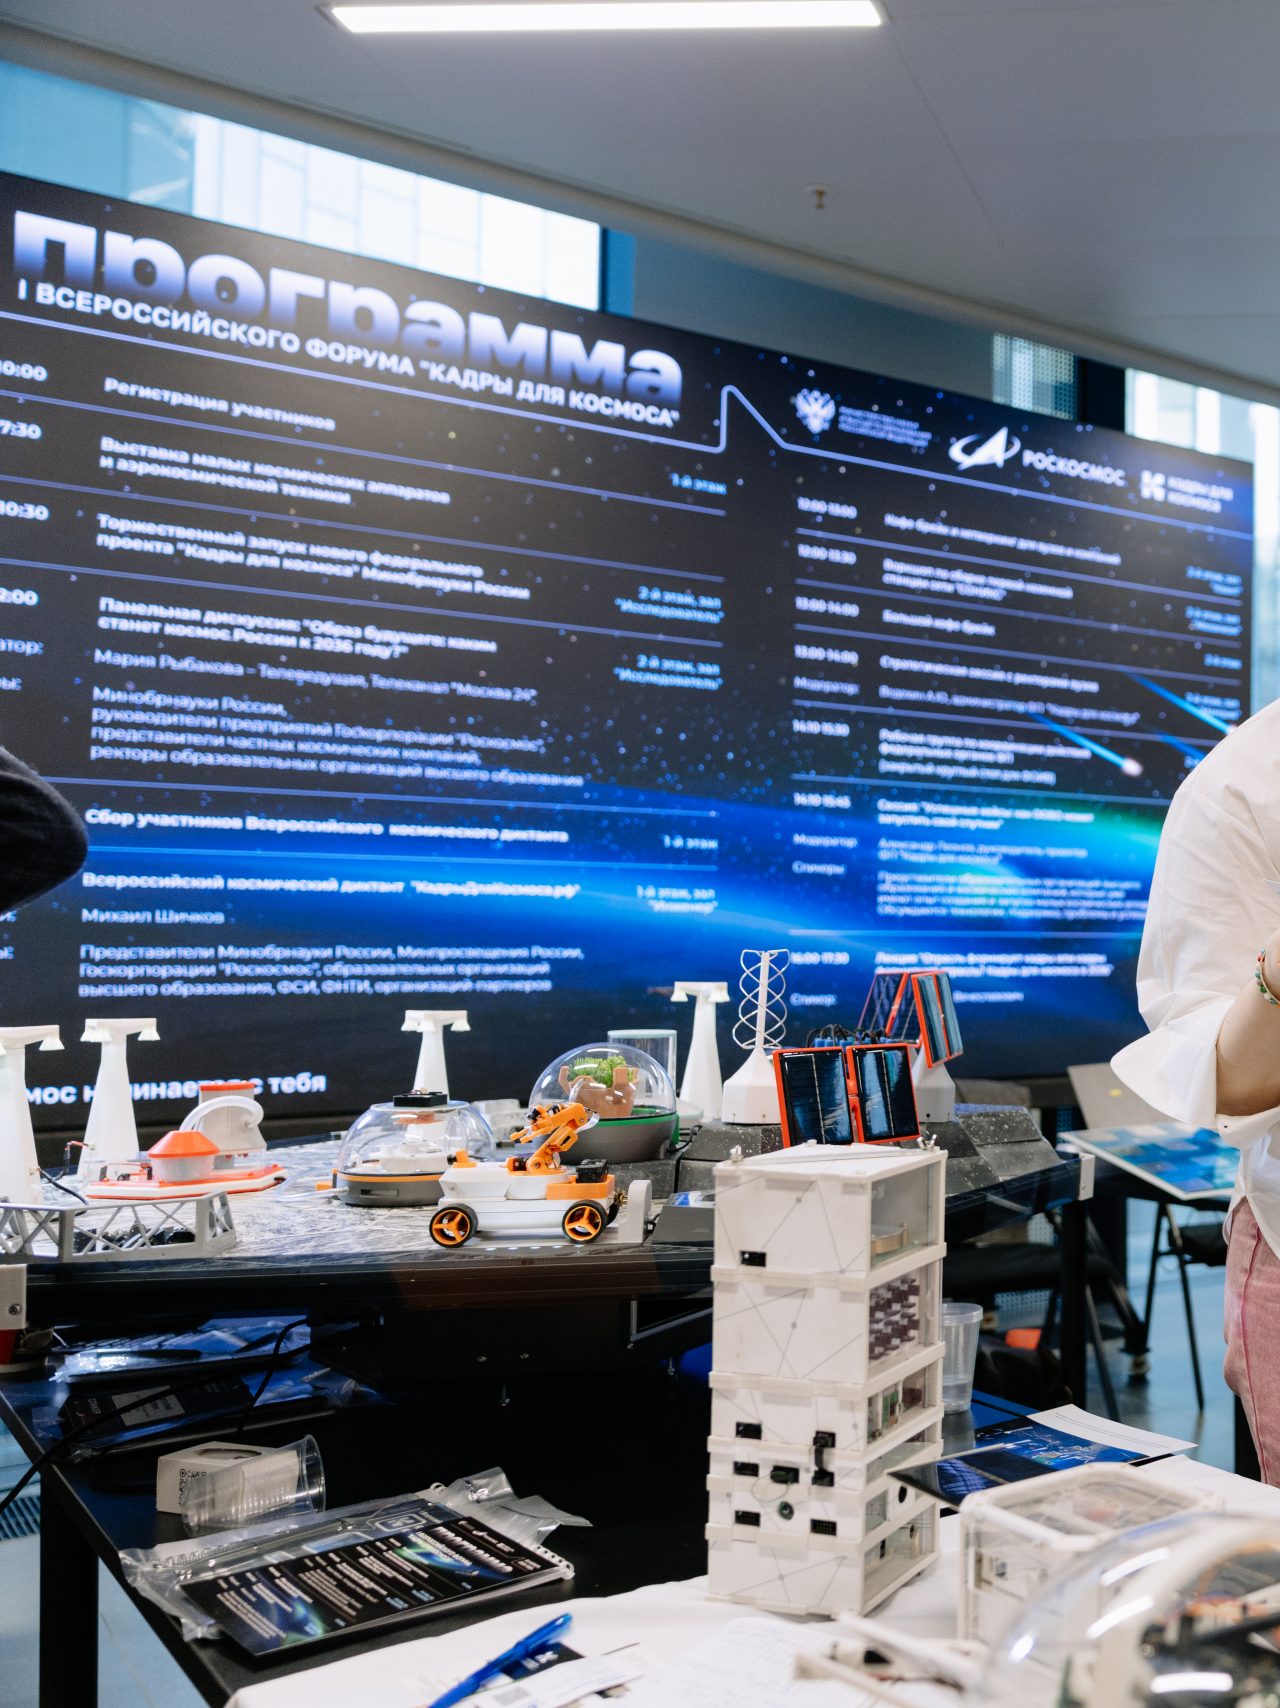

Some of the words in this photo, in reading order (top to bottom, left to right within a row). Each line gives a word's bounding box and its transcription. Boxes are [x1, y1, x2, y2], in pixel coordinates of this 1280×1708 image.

[14, 210, 683, 407] программа
[0, 360, 48, 382] 0:00
[36, 281, 301, 353] ВСЕРОССИЙСКОГО
[304, 337, 415, 377] ФОРУМА
[419, 359, 513, 396] "КАДРЫ
[516, 379, 566, 406] ДЛЯ
[569, 390, 681, 428] КОСМОСА"
[104, 377, 229, 413] Регистрация
[231, 401, 336, 431] участников
[100, 455, 114, 469] и
[116, 460, 279, 494] аэрокосмической
[281, 483, 352, 504] техники
[101, 435, 190, 464] Выставка
[192, 452, 251, 474] малых
[253, 463, 365, 491] космических
[367, 480, 450, 505] аппаратов
[1022, 449, 1127, 488] РОСКОСМОС
[97, 512, 246, 547] Торжественный
[247, 535, 307, 555] запуск
[308, 544, 368, 563] нового
[369, 550, 484, 578] федерального
[24, 1085, 78, 1105] мос
[267, 1071, 327, 1094] тебя
